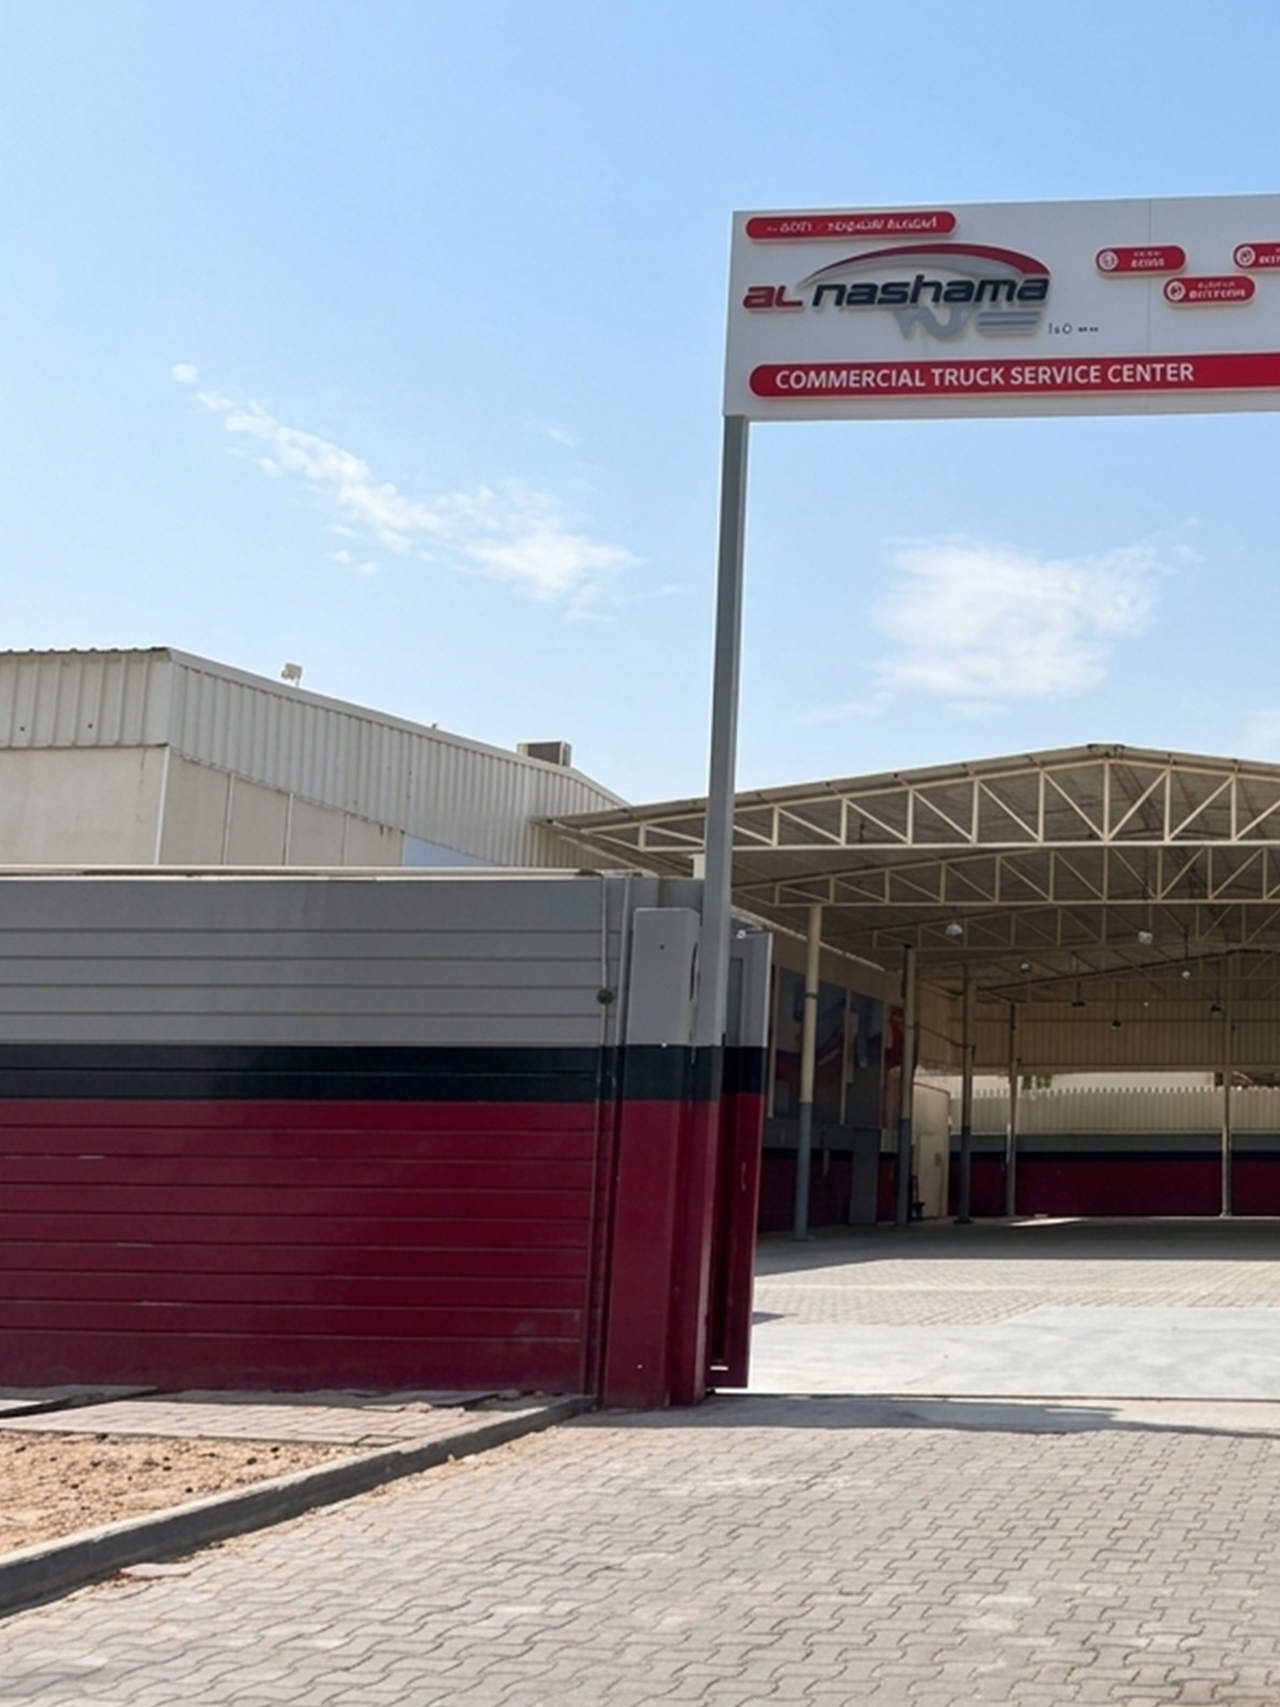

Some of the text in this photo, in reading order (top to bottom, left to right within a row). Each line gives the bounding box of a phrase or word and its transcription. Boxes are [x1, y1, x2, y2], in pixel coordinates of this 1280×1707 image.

[775, 362, 1194, 390] COMMERCIAL TRUCK SERVICE CENTER
